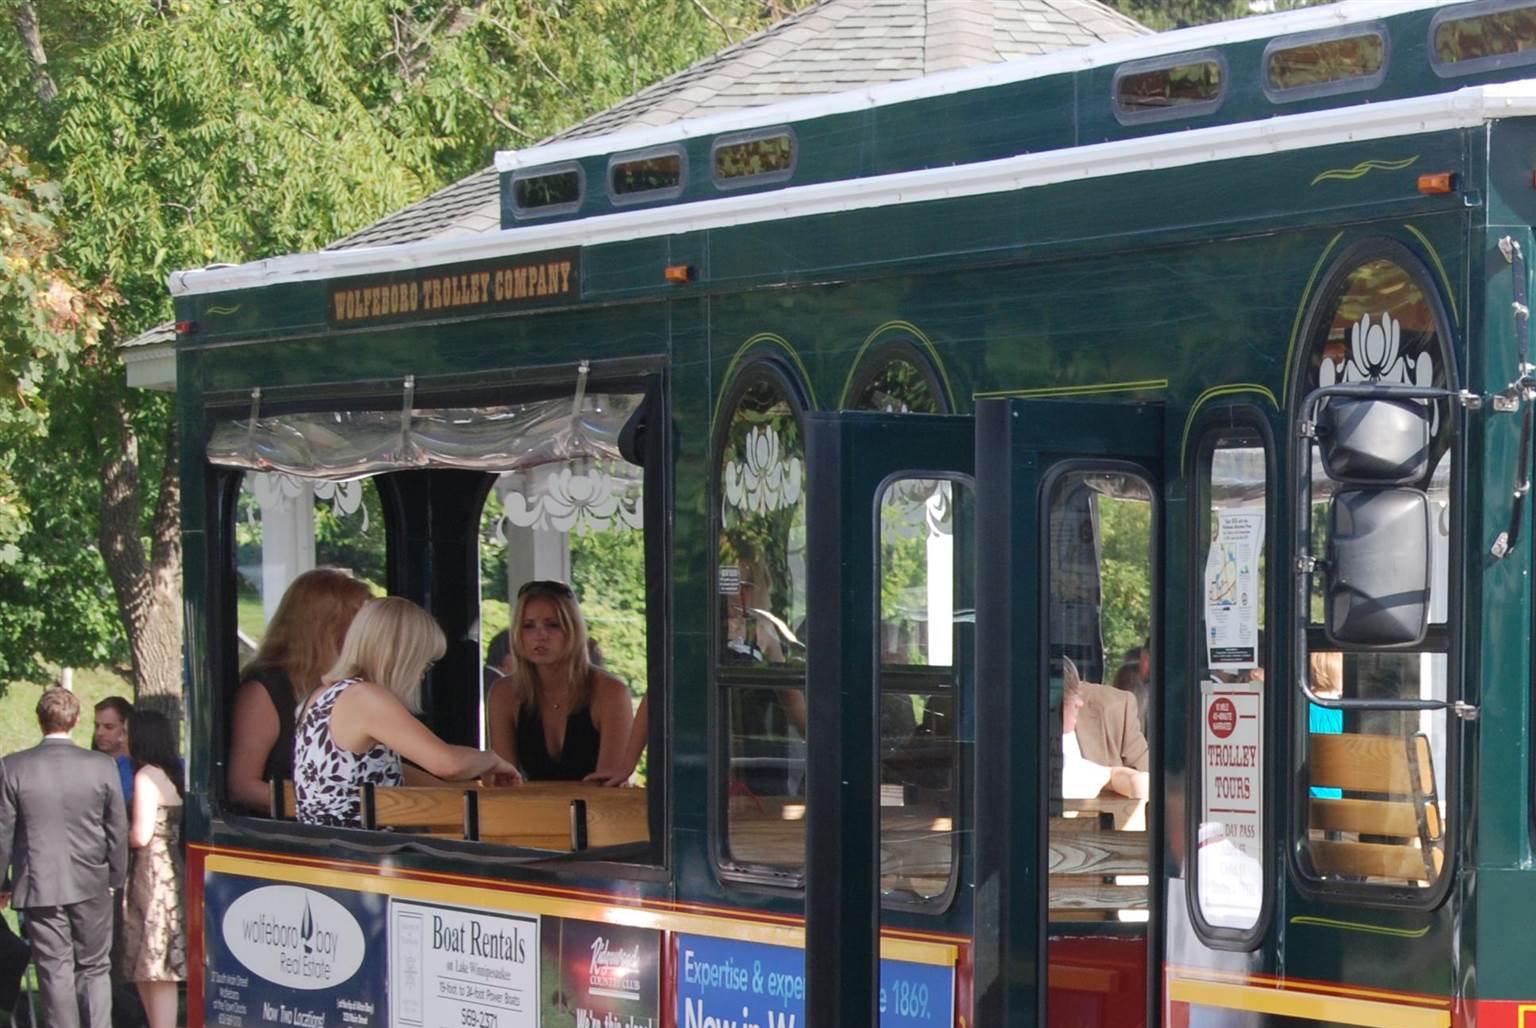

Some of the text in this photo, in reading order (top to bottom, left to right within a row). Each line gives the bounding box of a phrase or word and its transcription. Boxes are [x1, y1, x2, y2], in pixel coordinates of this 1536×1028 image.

[334, 260, 572, 321] WOLFEBORO TROLLEY COMPANY
[1207, 744, 1256, 768] TROLLEY
[1214, 775, 1251, 800] TOURS
[1225, 823, 1238, 838] DAY
[1239, 824, 1256, 839] PASS
[242, 912, 339, 962] wolfeboro bay
[432, 915, 466, 954] Boat
[470, 920, 526, 964] Rentals
[280, 952, 331, 980] Real Estate
[685, 950, 749, 993] Expertise
[752, 961, 764, 994] &
[622, 978, 640, 991] CLUB
[261, 1001, 278, 1022] Now
[279, 1004, 293, 1025] Two
[892, 979, 931, 1020] 1869.
